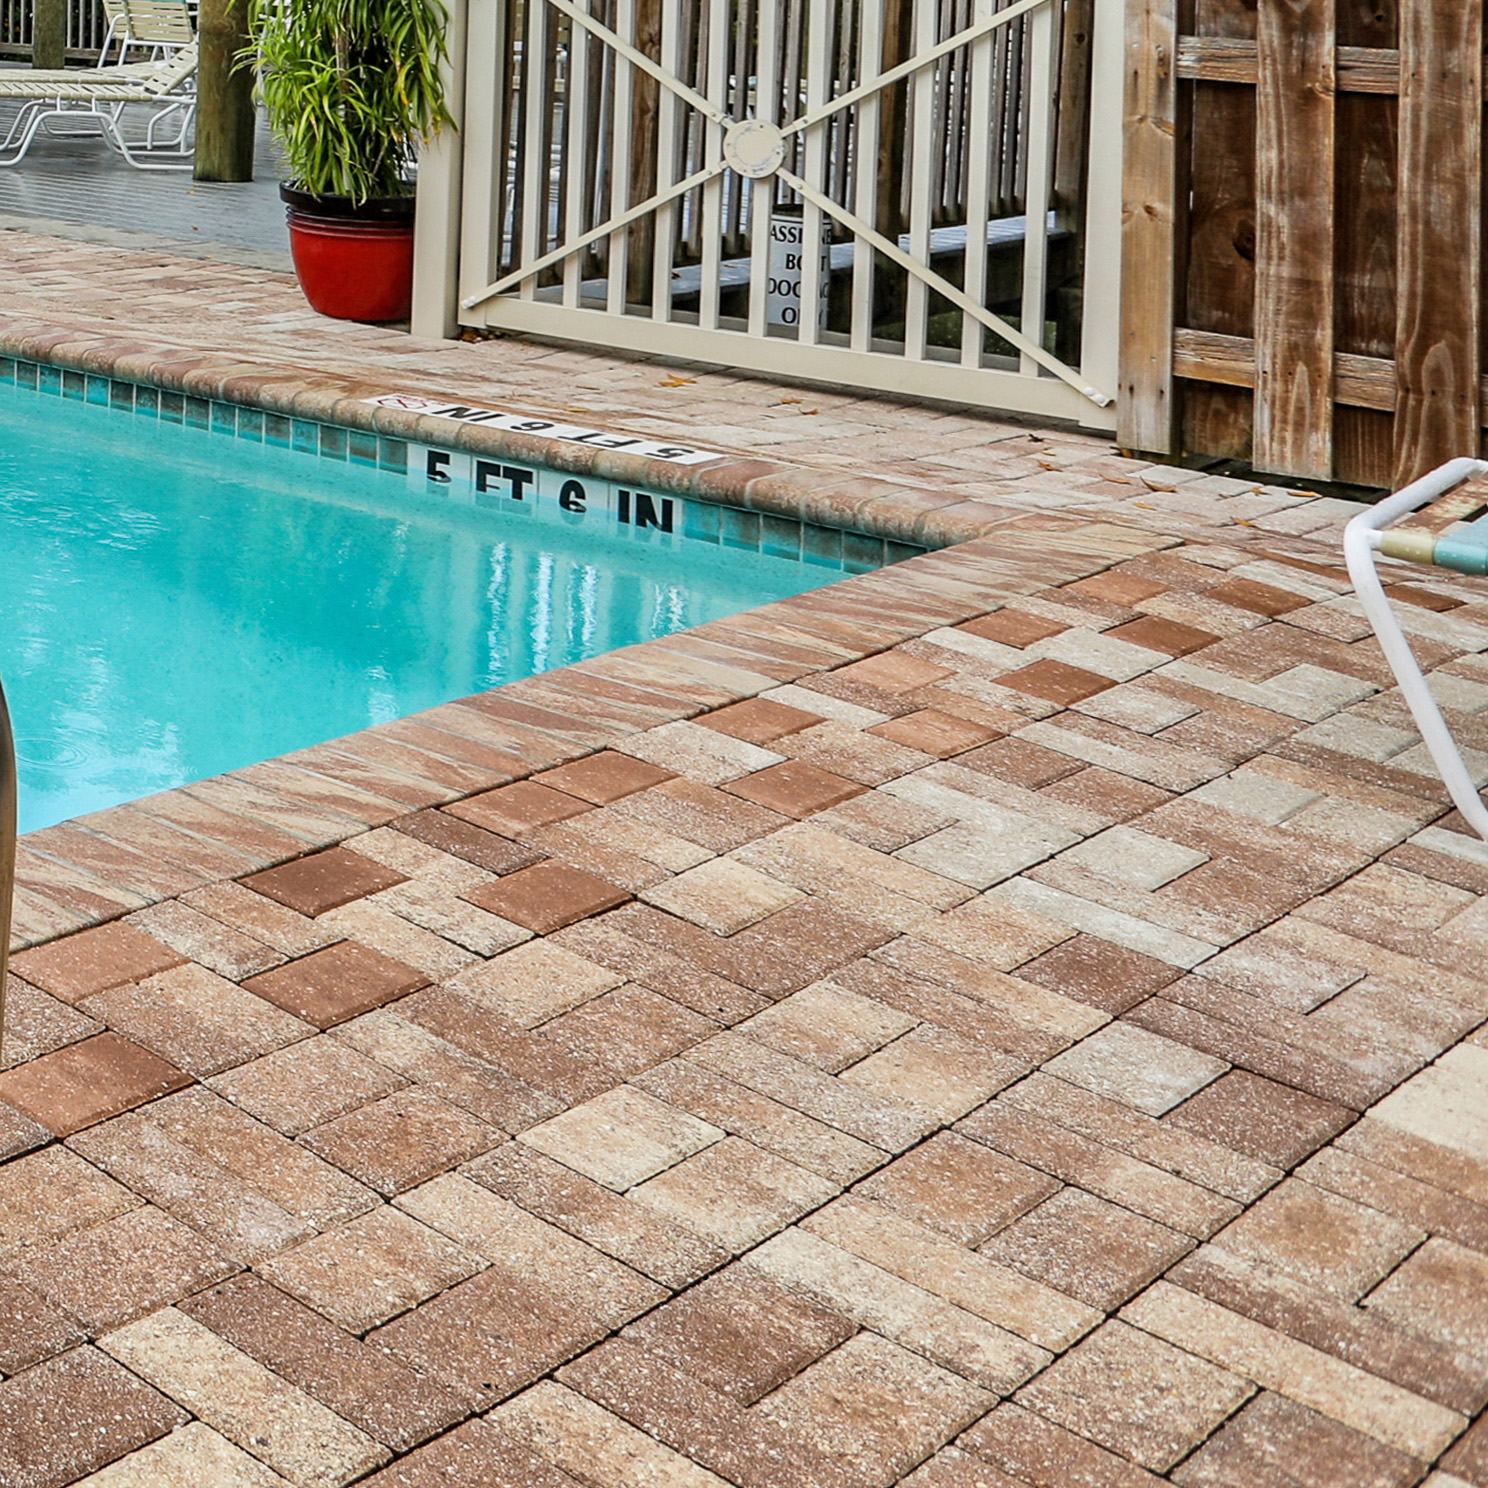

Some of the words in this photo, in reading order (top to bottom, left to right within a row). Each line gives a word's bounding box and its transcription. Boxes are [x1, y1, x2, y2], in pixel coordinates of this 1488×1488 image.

[431, 405, 506, 422] IN
[510, 421, 555, 432] 6
[557, 432, 643, 448] FT
[644, 447, 697, 459] 5
[426, 450, 452, 483] 5
[475, 460, 534, 500] FT
[559, 479, 587, 513] 6
[617, 489, 674, 534] IN
